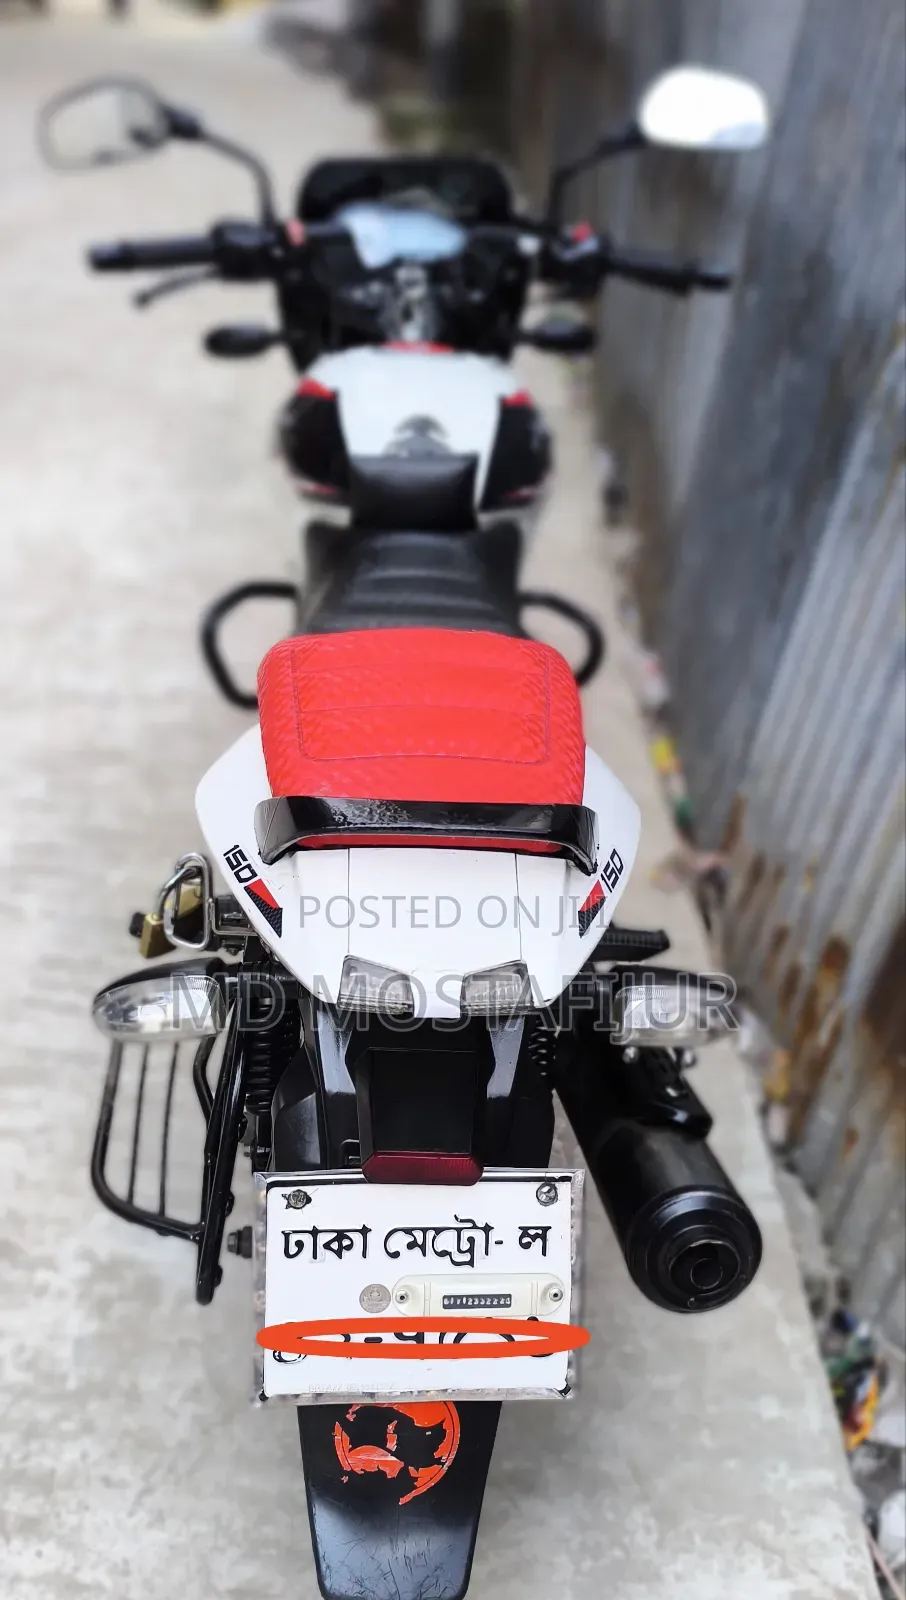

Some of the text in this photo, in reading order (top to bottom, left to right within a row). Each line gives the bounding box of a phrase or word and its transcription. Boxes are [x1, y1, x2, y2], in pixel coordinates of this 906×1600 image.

[223, 844, 258, 883] 150
[600, 848, 624, 893] 150
[281, 1223, 372, 1260] ঢাকা
[518, 1225, 552, 1257] ল
